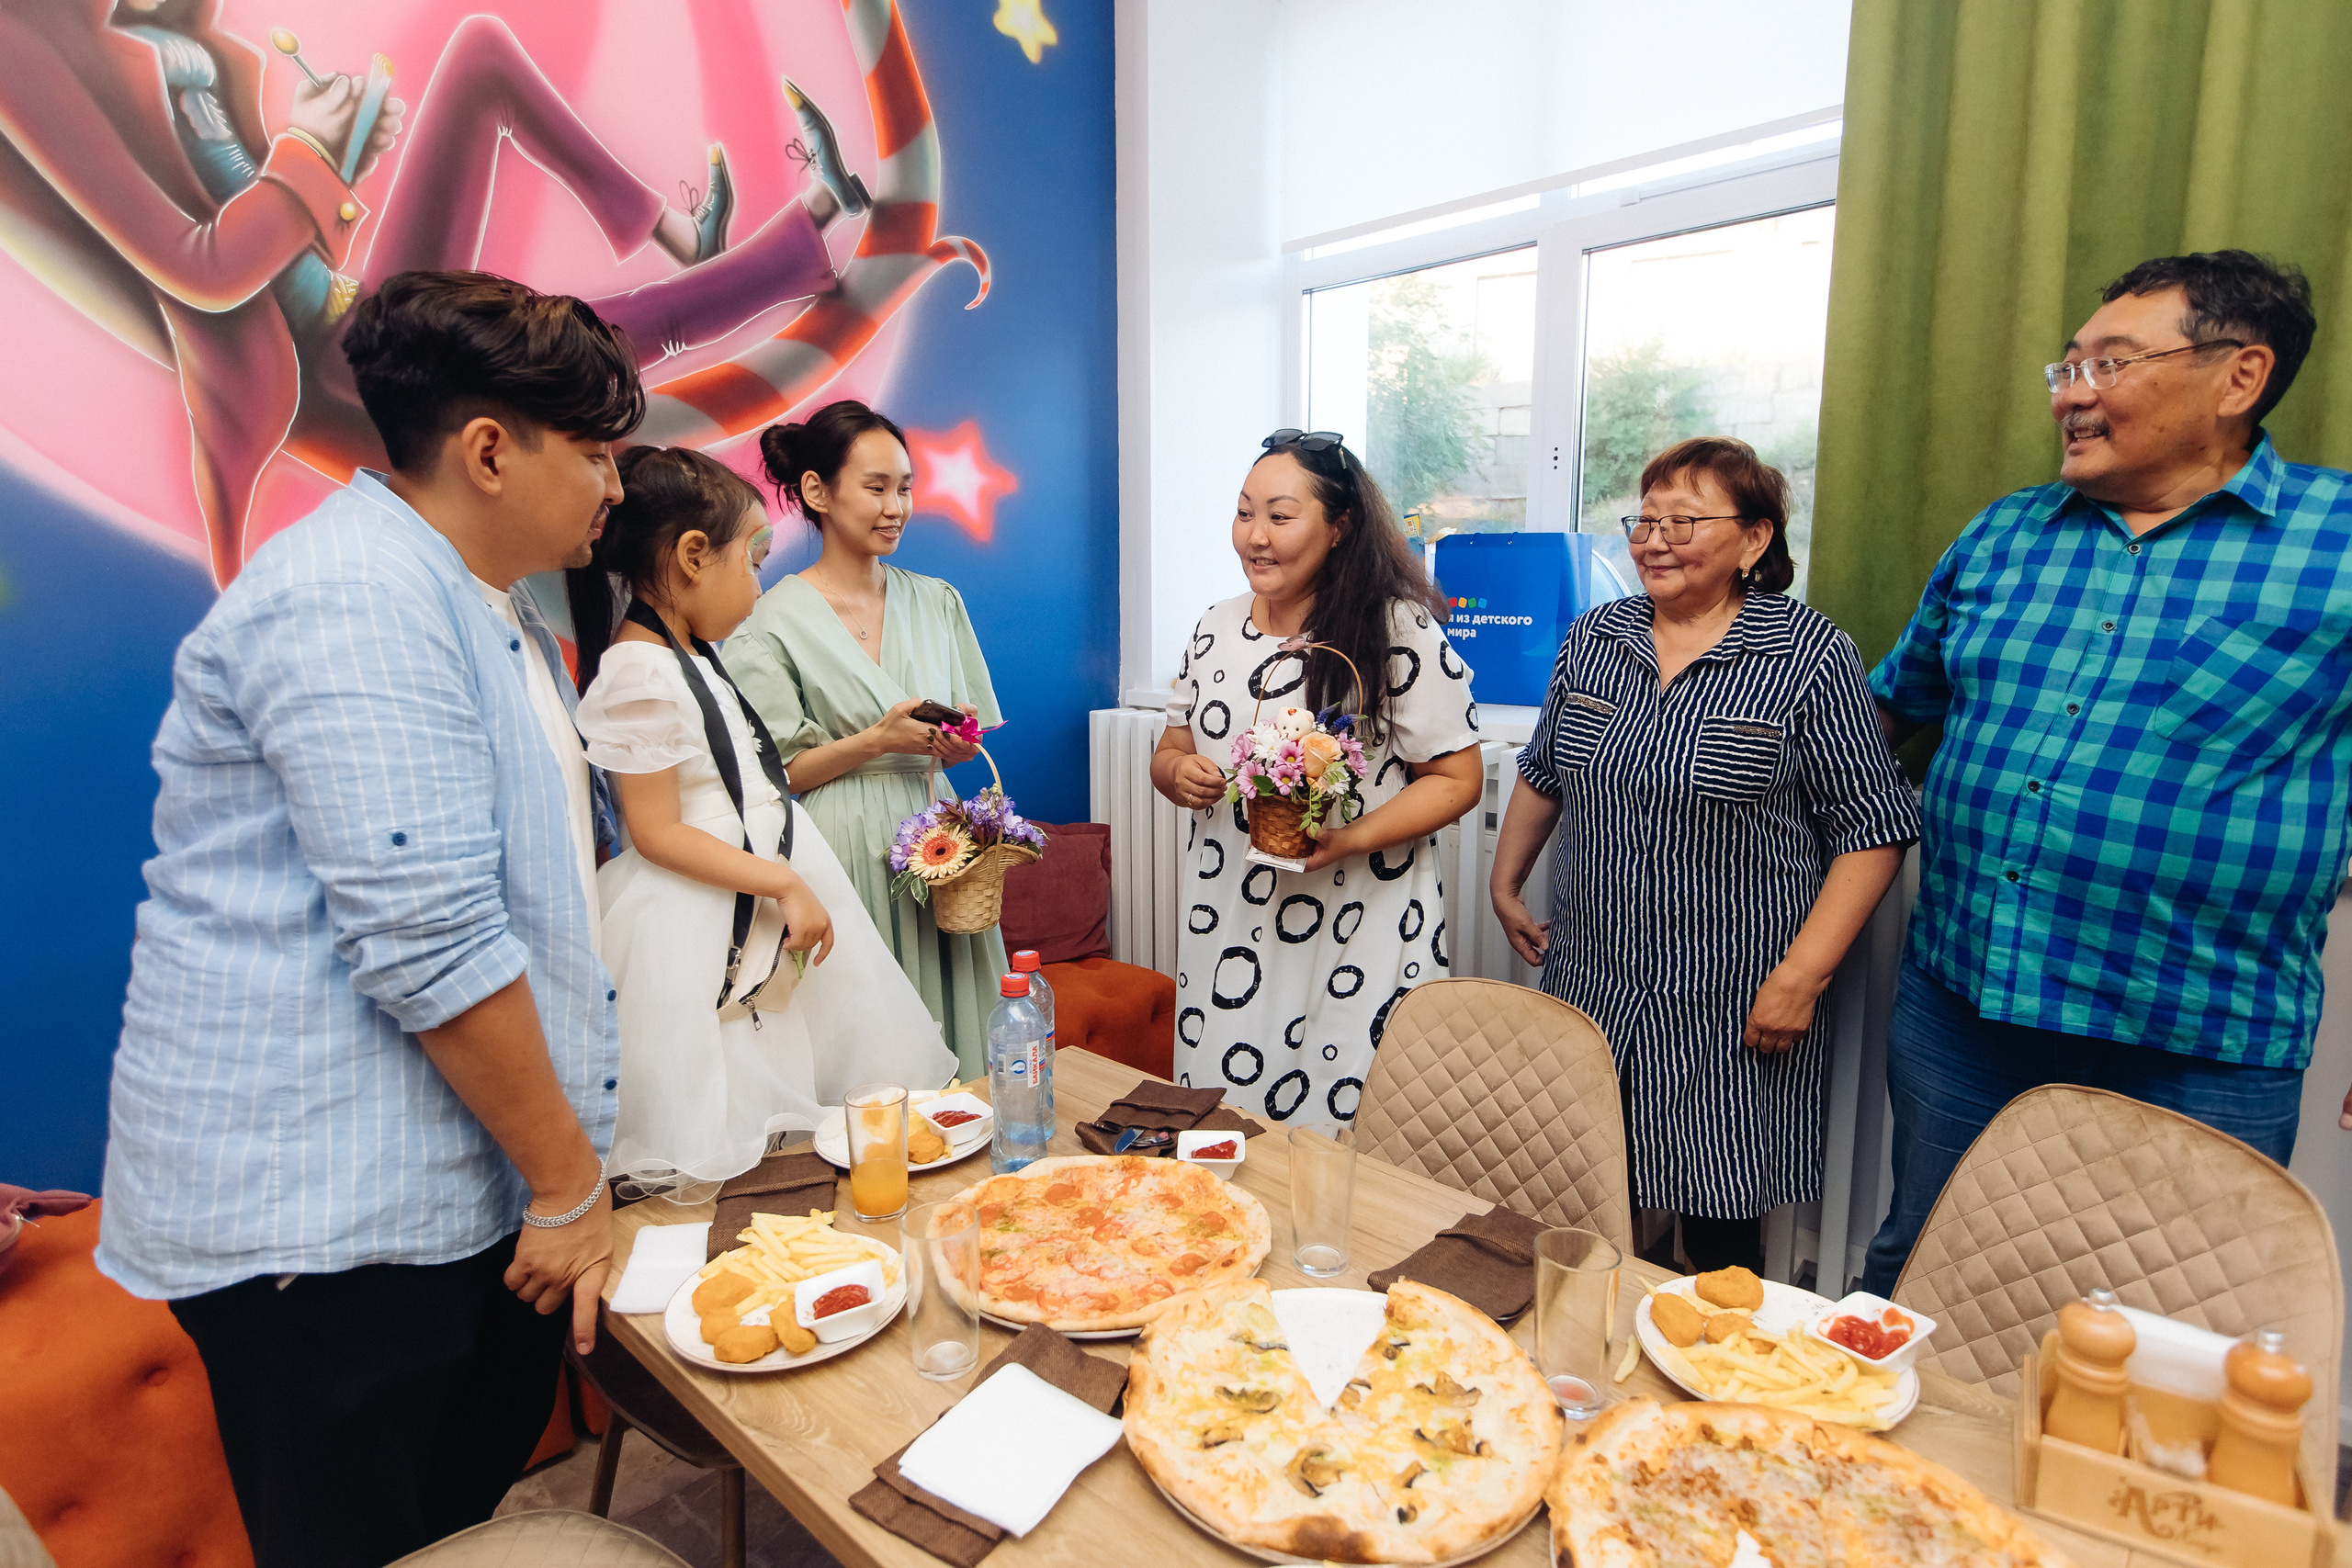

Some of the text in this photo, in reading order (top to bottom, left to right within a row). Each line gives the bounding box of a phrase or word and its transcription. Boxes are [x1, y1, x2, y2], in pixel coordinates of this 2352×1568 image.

[1455, 614, 1470, 624] из
[1472, 615, 1533, 626] детского
[1447, 627, 1476, 641] мира
